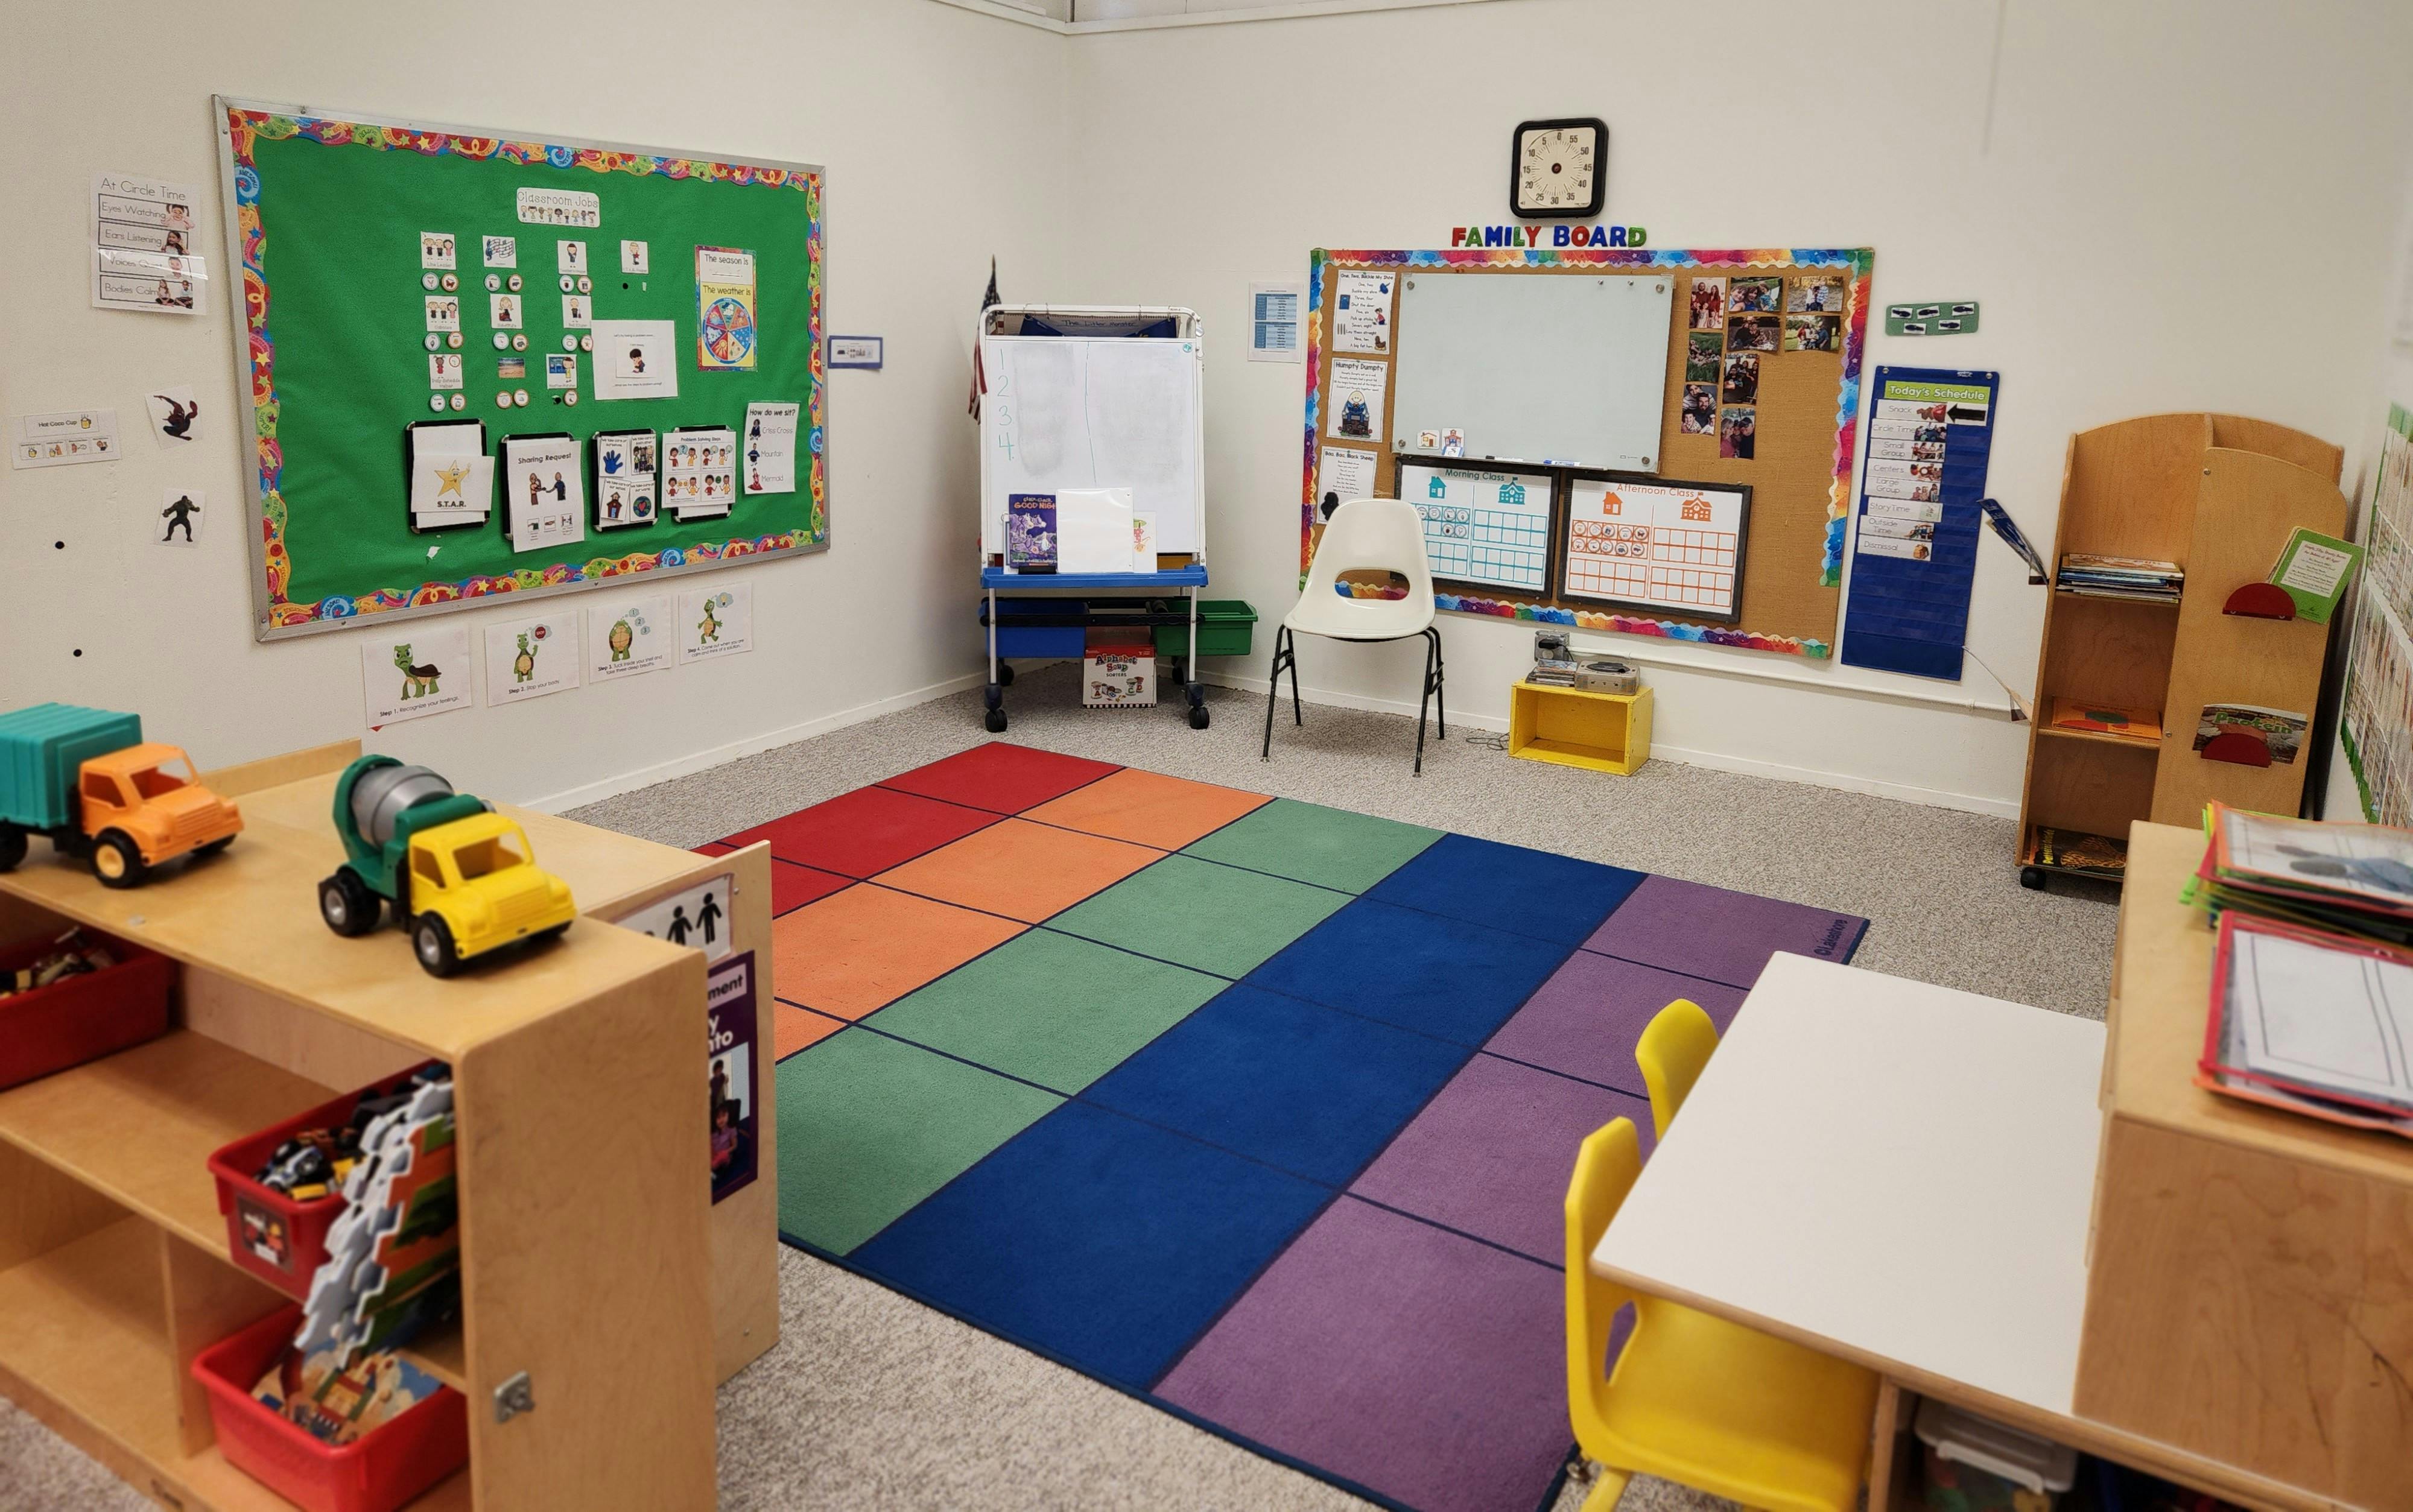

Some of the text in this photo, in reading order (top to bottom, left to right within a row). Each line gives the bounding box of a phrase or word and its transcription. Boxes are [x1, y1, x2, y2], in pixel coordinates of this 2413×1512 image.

[1570, 135, 1578, 144] 55
[1529, 149, 1535, 157] 10
[101, 177, 186, 200] At Circle Time
[517, 191, 598, 208] Classroom Jobs
[102, 202, 166, 219] Eyes Watching
[106, 230, 162, 246] Ears Listening
[1451, 226, 1647, 248] FAMILY BOARD
[110, 256, 136, 267] Voices
[705, 254, 717, 262] The
[718, 256, 742, 265] season
[105, 283, 158, 296] Bodies Calm
[703, 285, 715, 294] The
[717, 286, 744, 296] weather
[999, 349, 1004, 370] 1
[1336, 362, 1384, 372] Humpty Dumpty
[997, 375, 1009, 397] 2
[1889, 385, 1985, 400] Today's Schedule
[1889, 405, 1912, 414] Snack
[998, 405, 1012, 426] 3
[518, 453, 571, 464] Sharing Request
[1881, 449, 1906, 458] Group
[1874, 464, 1904, 474] Centers
[1445, 468, 1505, 482] Morning Class
[1876, 478, 1900, 486] Large
[1617, 483, 1695, 498] Afternoon Class
[1876, 485, 1901, 495] Group
[1870, 502, 1911, 513] Story Time
[1869, 517, 1898, 527] Outside
[1872, 526, 1892, 534] Time
[1863, 540, 1899, 551] Dismissal
[1096, 654, 1138, 666] Alphabet
[1106, 663, 1128, 672] Soup
[399, 703, 426, 713] Recognize
[2213, 712, 2293, 734] Protein
[708, 975, 743, 1001] ment
